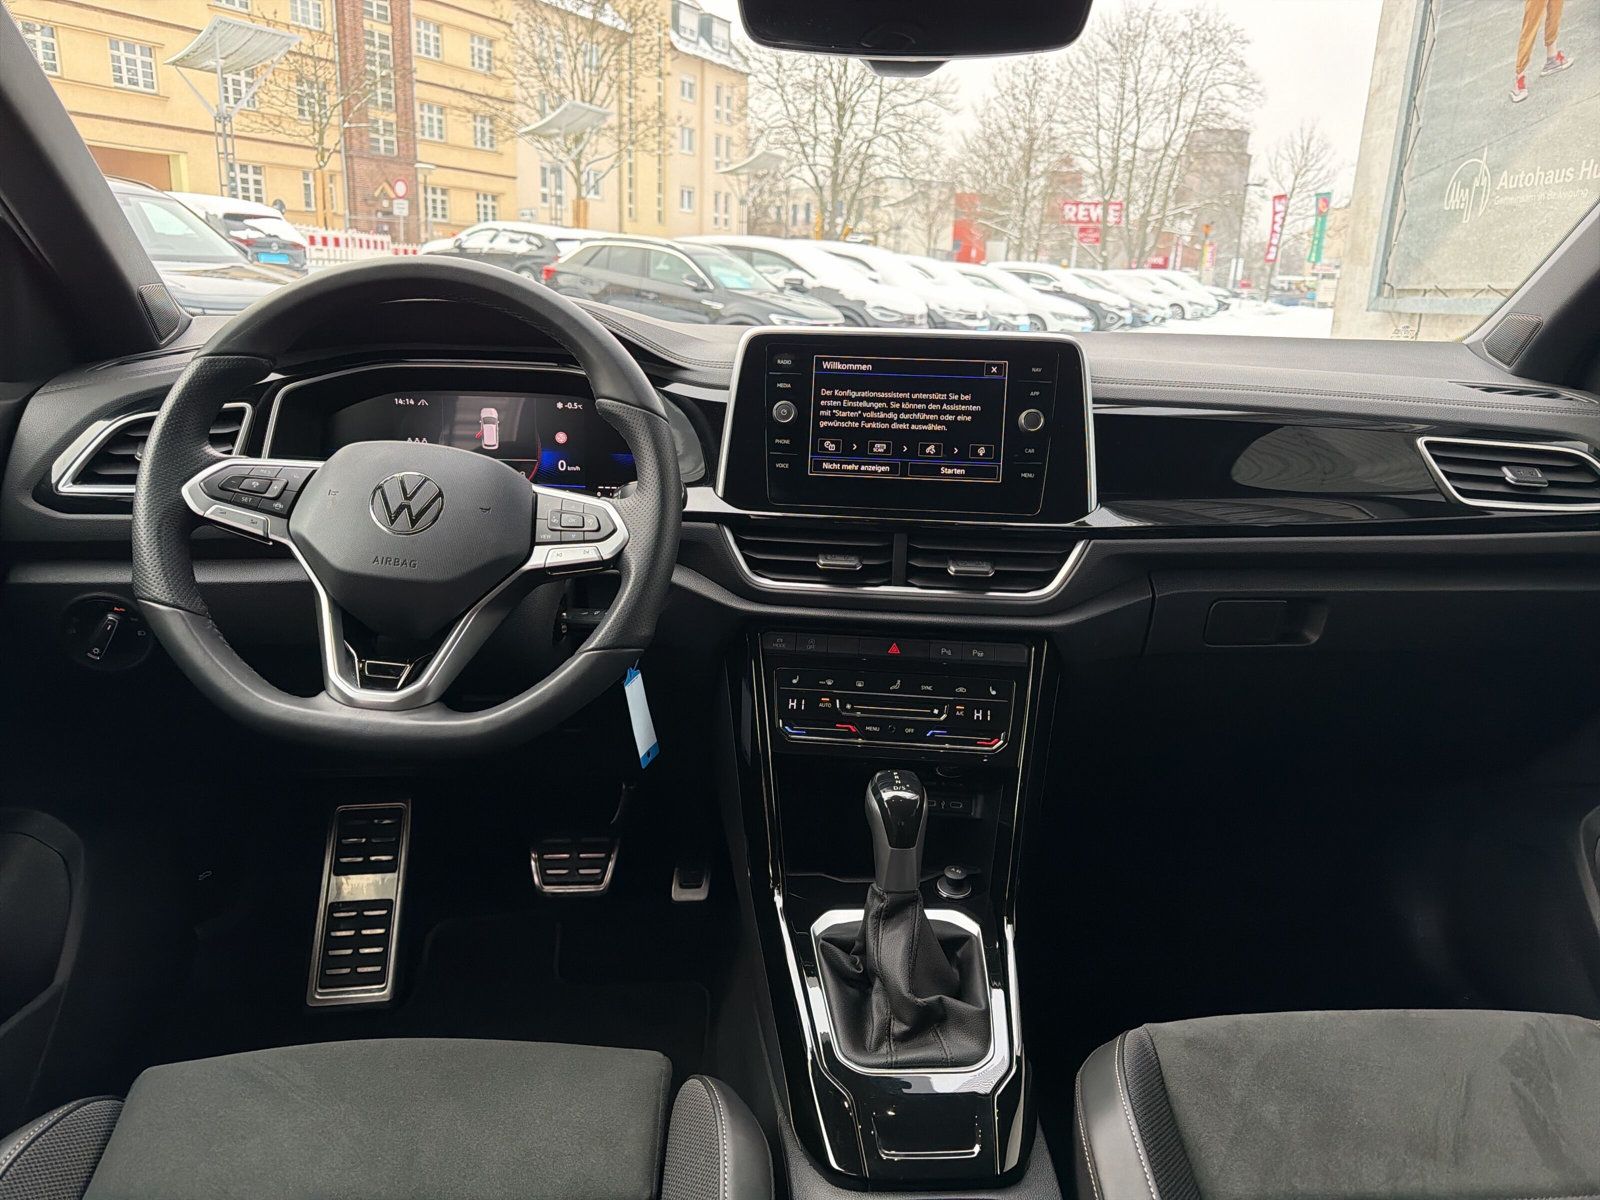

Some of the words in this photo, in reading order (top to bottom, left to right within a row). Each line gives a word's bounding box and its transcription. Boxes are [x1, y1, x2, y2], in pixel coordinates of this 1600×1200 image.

[1496, 166, 1575, 190] Autohaus
[1063, 204, 1123, 224] REWE
[822, 361, 872, 371] Willkommen
[820, 388, 833, 396] Der
[834, 389, 910, 399] Konfigurationsassistent
[911, 392, 947, 400] unterstützt
[948, 392, 959, 400] Sie
[960, 393, 971, 401] bei
[394, 398, 415, 406] 14:14
[842, 400, 888, 409] Einstellungen.
[890, 401, 900, 409] Sie
[901, 402, 926, 410] können
[927, 402, 941, 410] den
[942, 403, 981, 411] Assistenten
[862, 411, 898, 420] vollständig
[899, 412, 939, 420] durchführen
[956, 414, 972, 422] eine
[819, 420, 860, 428] gewünschte
[860, 420, 890, 429] Funktion
[890, 421, 909, 429] direkt
[910, 423, 948, 431] auswählen.
[558, 460, 566, 472] 0
[822, 462, 840, 470] Nicht
[860, 464, 890, 472] anzeigen
[940, 467, 966, 475] Starten
[372, 556, 418, 568] AIRBAG
[788, 698, 805, 710] HI
[974, 708, 991, 721] HI
